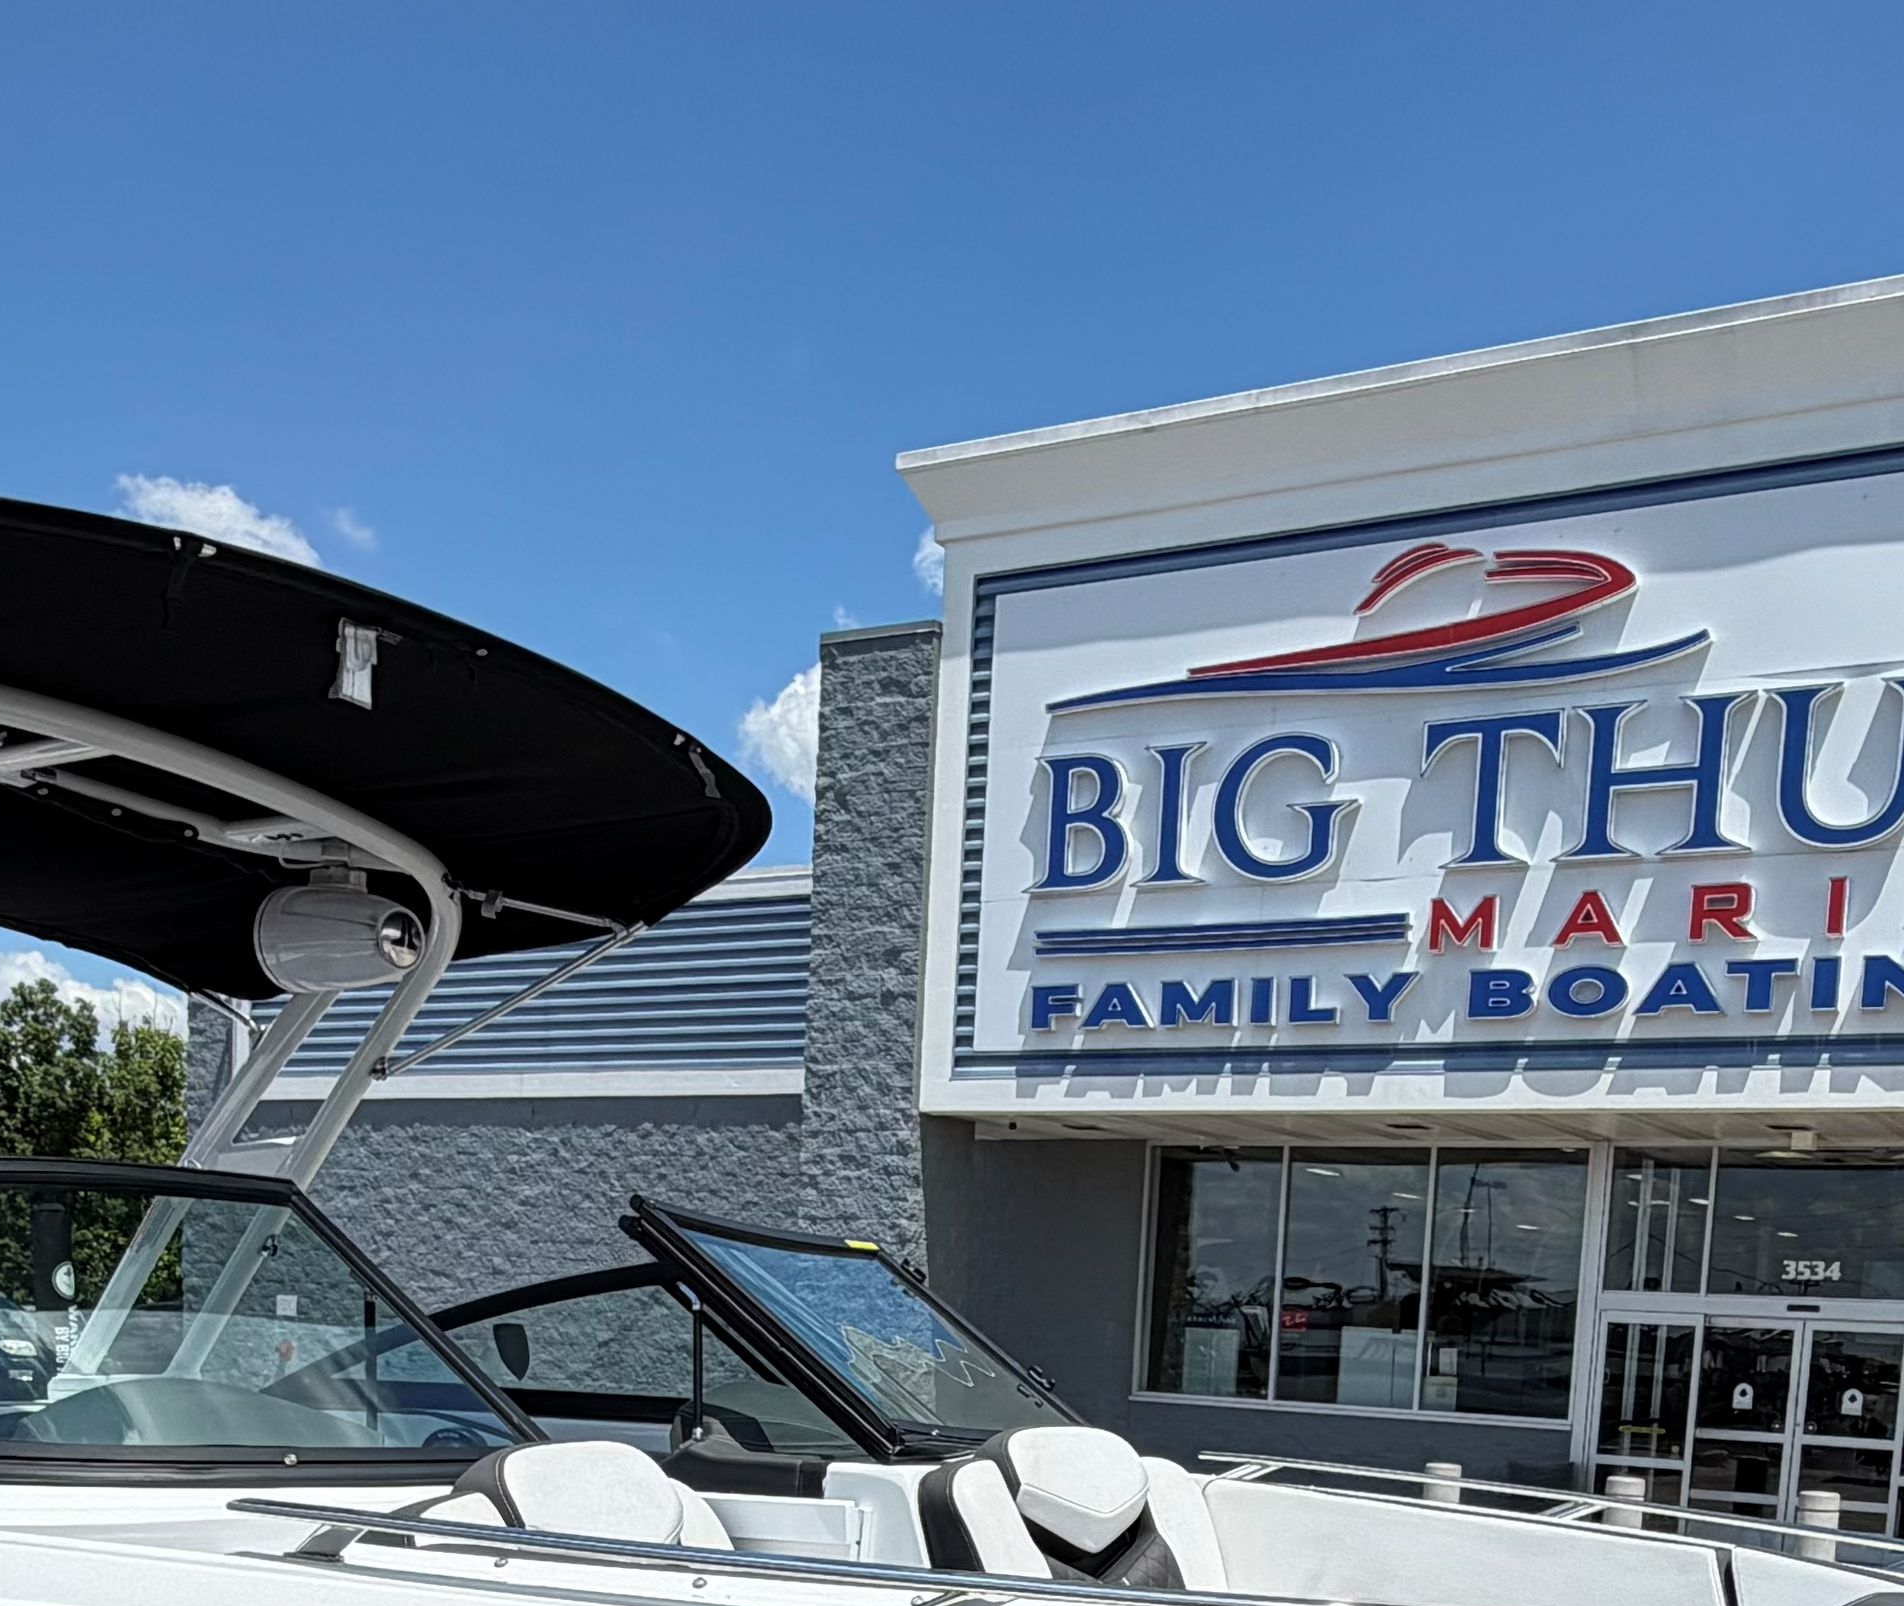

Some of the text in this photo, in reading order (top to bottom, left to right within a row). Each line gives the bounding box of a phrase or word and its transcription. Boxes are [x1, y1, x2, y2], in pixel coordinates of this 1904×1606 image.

[1027, 732, 1360, 893] BIG
[1030, 972, 1414, 1030] FAMILY
[1781, 1259, 1842, 1281] 3534
[67, 1305, 81, 1345] WAK
